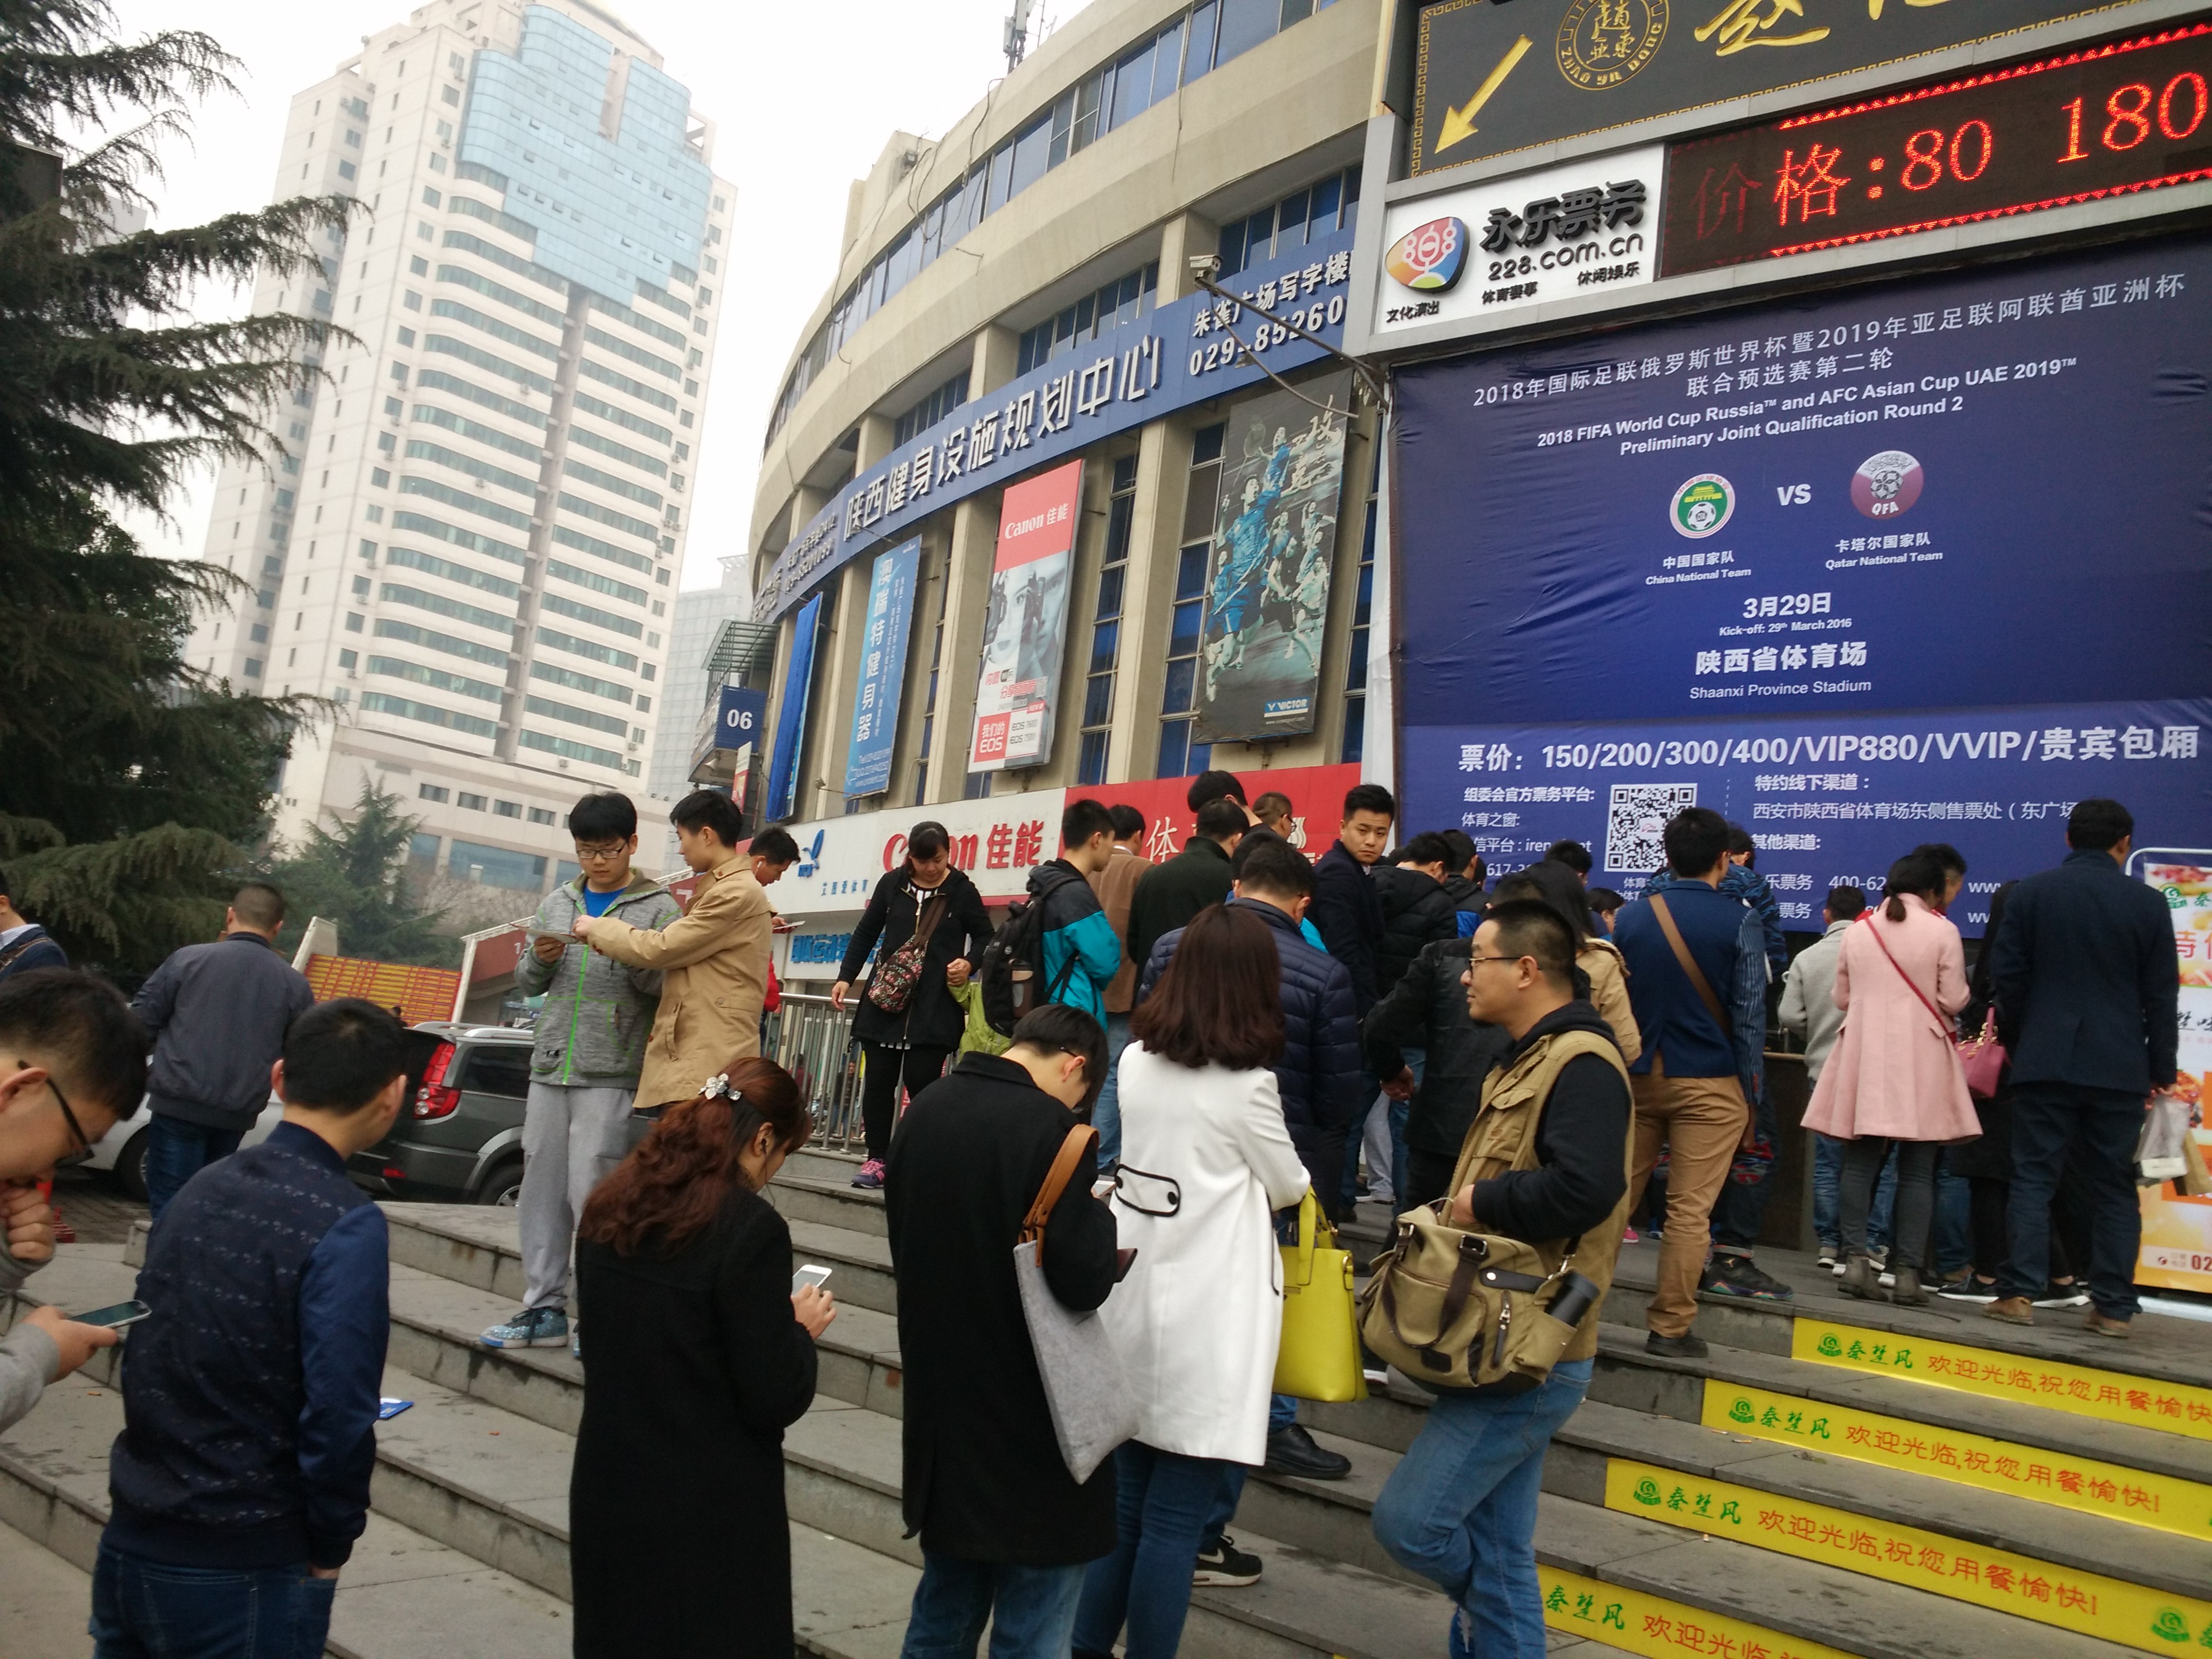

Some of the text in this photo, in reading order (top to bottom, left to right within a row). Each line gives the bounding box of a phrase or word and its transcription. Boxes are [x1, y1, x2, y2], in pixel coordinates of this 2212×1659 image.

[2057, 71, 2208, 164] 180
[1480, 178, 1647, 252] 永乐票务
[1489, 232, 1643, 281] 228.com.cn
[1577, 261, 1640, 286] 休闲娱乐
[1192, 250, 1354, 338] 朱雀广场写字楼
[1481, 281, 1538, 305] 体育赛事
[1386, 299, 1440, 323] 文化演出
[1473, 272, 2185, 406] 2018年国际足联俄罗斯世界杯暨2019年亚足联阿联酋亚洲杯
[1687, 347, 1894, 399] 联合预选赛第二轮
[1538, 432, 1573, 447] 2018
[1577, 423, 1613, 441] FIFA
[1616, 415, 1663, 435] World
[1668, 412, 1700, 430] Cup
[1781, 394, 1814, 410] and
[1819, 387, 1858, 406] AFC
[1862, 381, 1915, 398] Asian
[1921, 375, 1960, 393] Cup
[1965, 367, 2008, 386] UAE
[843, 333, 1164, 543] 陕西健身设施规划中心
[1620, 396, 1963, 456] Preliminary Joint Qualification Round 2
[1777, 484, 1812, 506] VS
[1872, 501, 1899, 516] QFA
[1004, 502, 1069, 540] Canon 佳能
[1835, 532, 1931, 553] 卡塔尔国家队
[1663, 550, 1735, 569] 中国国家队
[1825, 551, 1943, 571] Qatar National Team
[1646, 569, 1752, 585] China National Team
[1742, 592, 1831, 618] 3月29日
[1768, 623, 1788, 633] 29th
[1791, 619, 1825, 631] March
[1826, 618, 1852, 629] 2016
[1695, 641, 1867, 675] 陕西省体育场
[1689, 680, 1872, 699] Shaanxi Province Stadium
[1277, 699, 1308, 710] VICTOR
[726, 709, 753, 730] 06
[1012, 722, 1025, 731] EOS
[979, 736, 1003, 753] EOS
[1010, 735, 1023, 744] EOS
[1463, 786, 1595, 802] 组委会官方票务平台:
[1755, 773, 1870, 792] 特约线下渠道：
[1461, 812, 1520, 827] 体育之窗:
[986, 820, 1044, 869] 佳能
[1752, 834, 1821, 850] 其他渠道:
[1847, 1339, 1913, 1369] 秦楚风
[1761, 1405, 1830, 1439] 秦楚风
[1667, 1487, 1741, 1524] 秦楚风
[1546, 1585, 1624, 1630] 秦楚风
